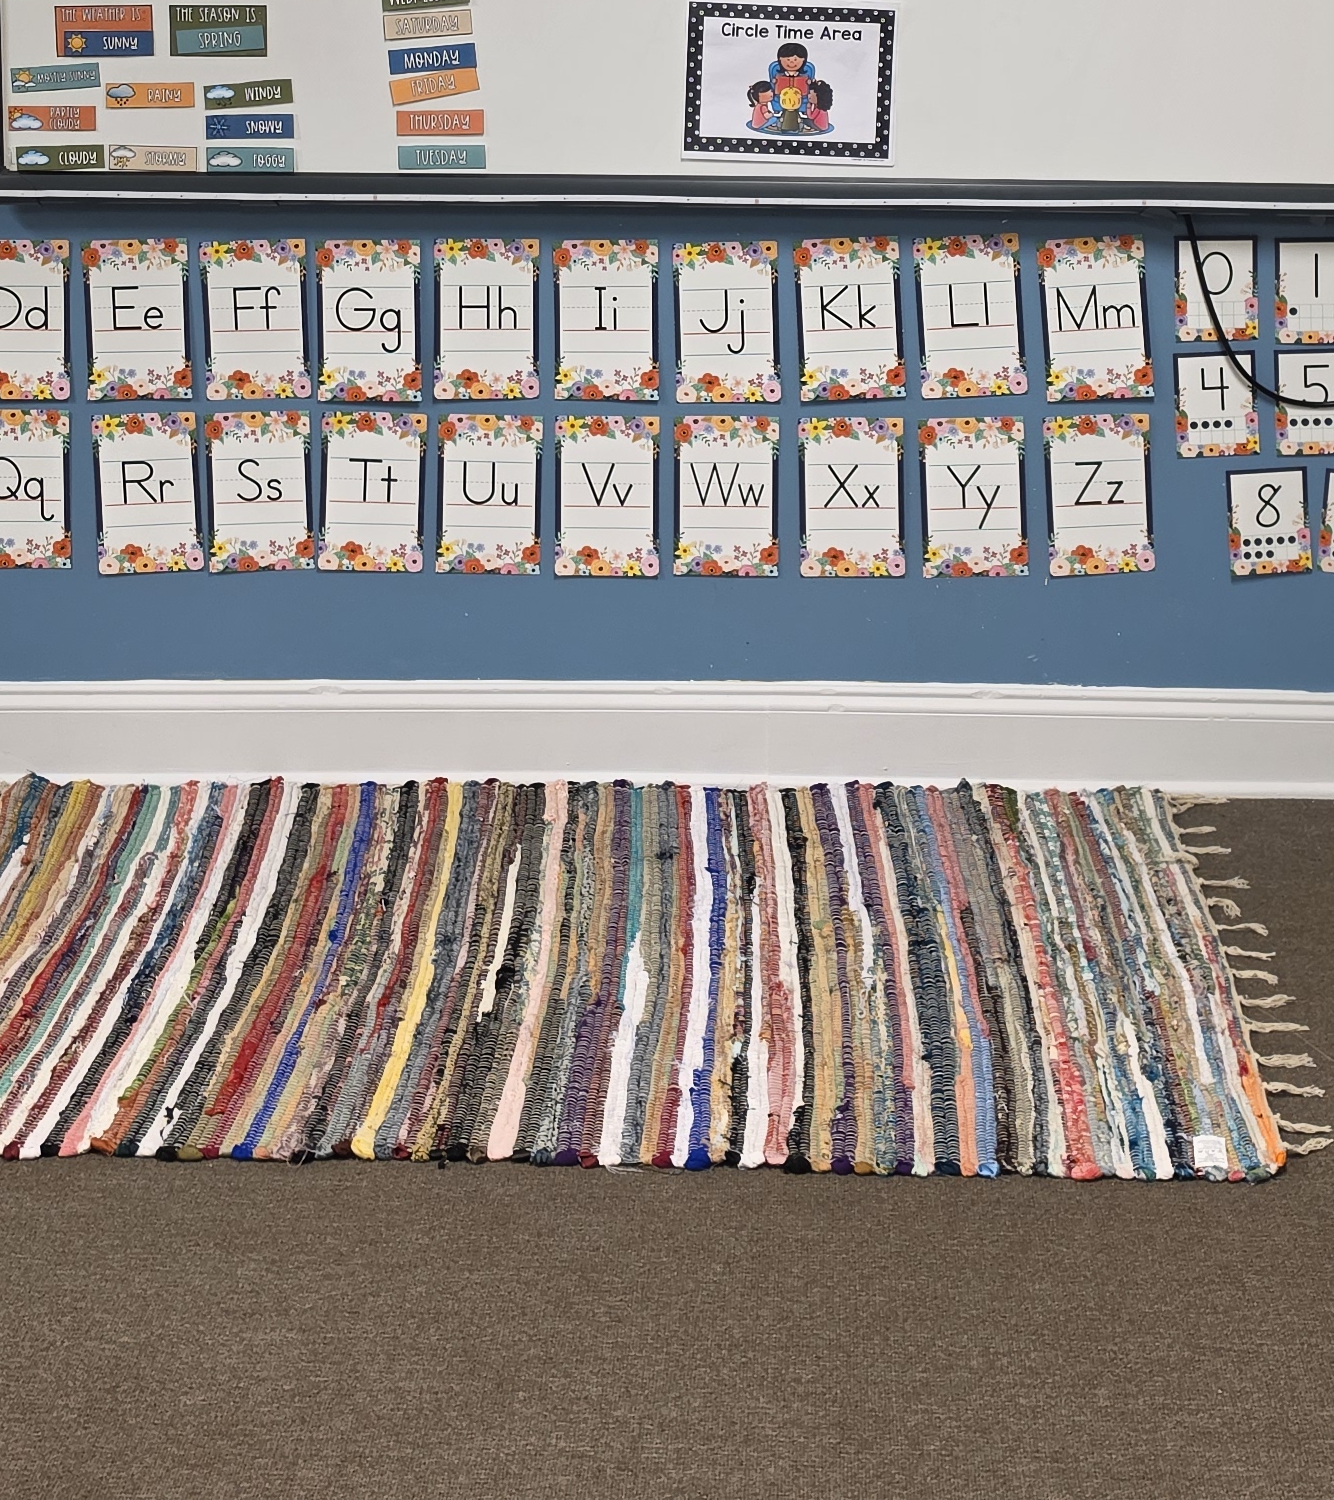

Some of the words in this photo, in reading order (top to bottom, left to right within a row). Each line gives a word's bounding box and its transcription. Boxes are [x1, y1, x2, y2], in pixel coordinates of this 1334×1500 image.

[176, 7, 193, 22] THE
[199, 7, 240, 22] SEASON
[721, 22, 769, 38] Circle
[775, 25, 814, 40] Time
[820, 26, 863, 42] Area
[102, 35, 138, 51] SUNNY
[198, 31, 242, 49] SPRING
[244, 85, 283, 103] WINDY
[245, 119, 283, 135] SNOWY
[58, 151, 98, 166] CLOUDY
[415, 149, 468, 166] TUESDAY
[111, 285, 164, 331] Ee
[335, 287, 403, 353] Gg
[820, 284, 877, 330] Kk
[1056, 285, 1136, 331] Mm
[1201, 366, 1229, 411] 4
[122, 461, 174, 504] Rr
[349, 458, 398, 502] Tt
[690, 462, 764, 507] Ww
[1074, 461, 1125, 506] Zz
[1255, 483, 1283, 527] 8
